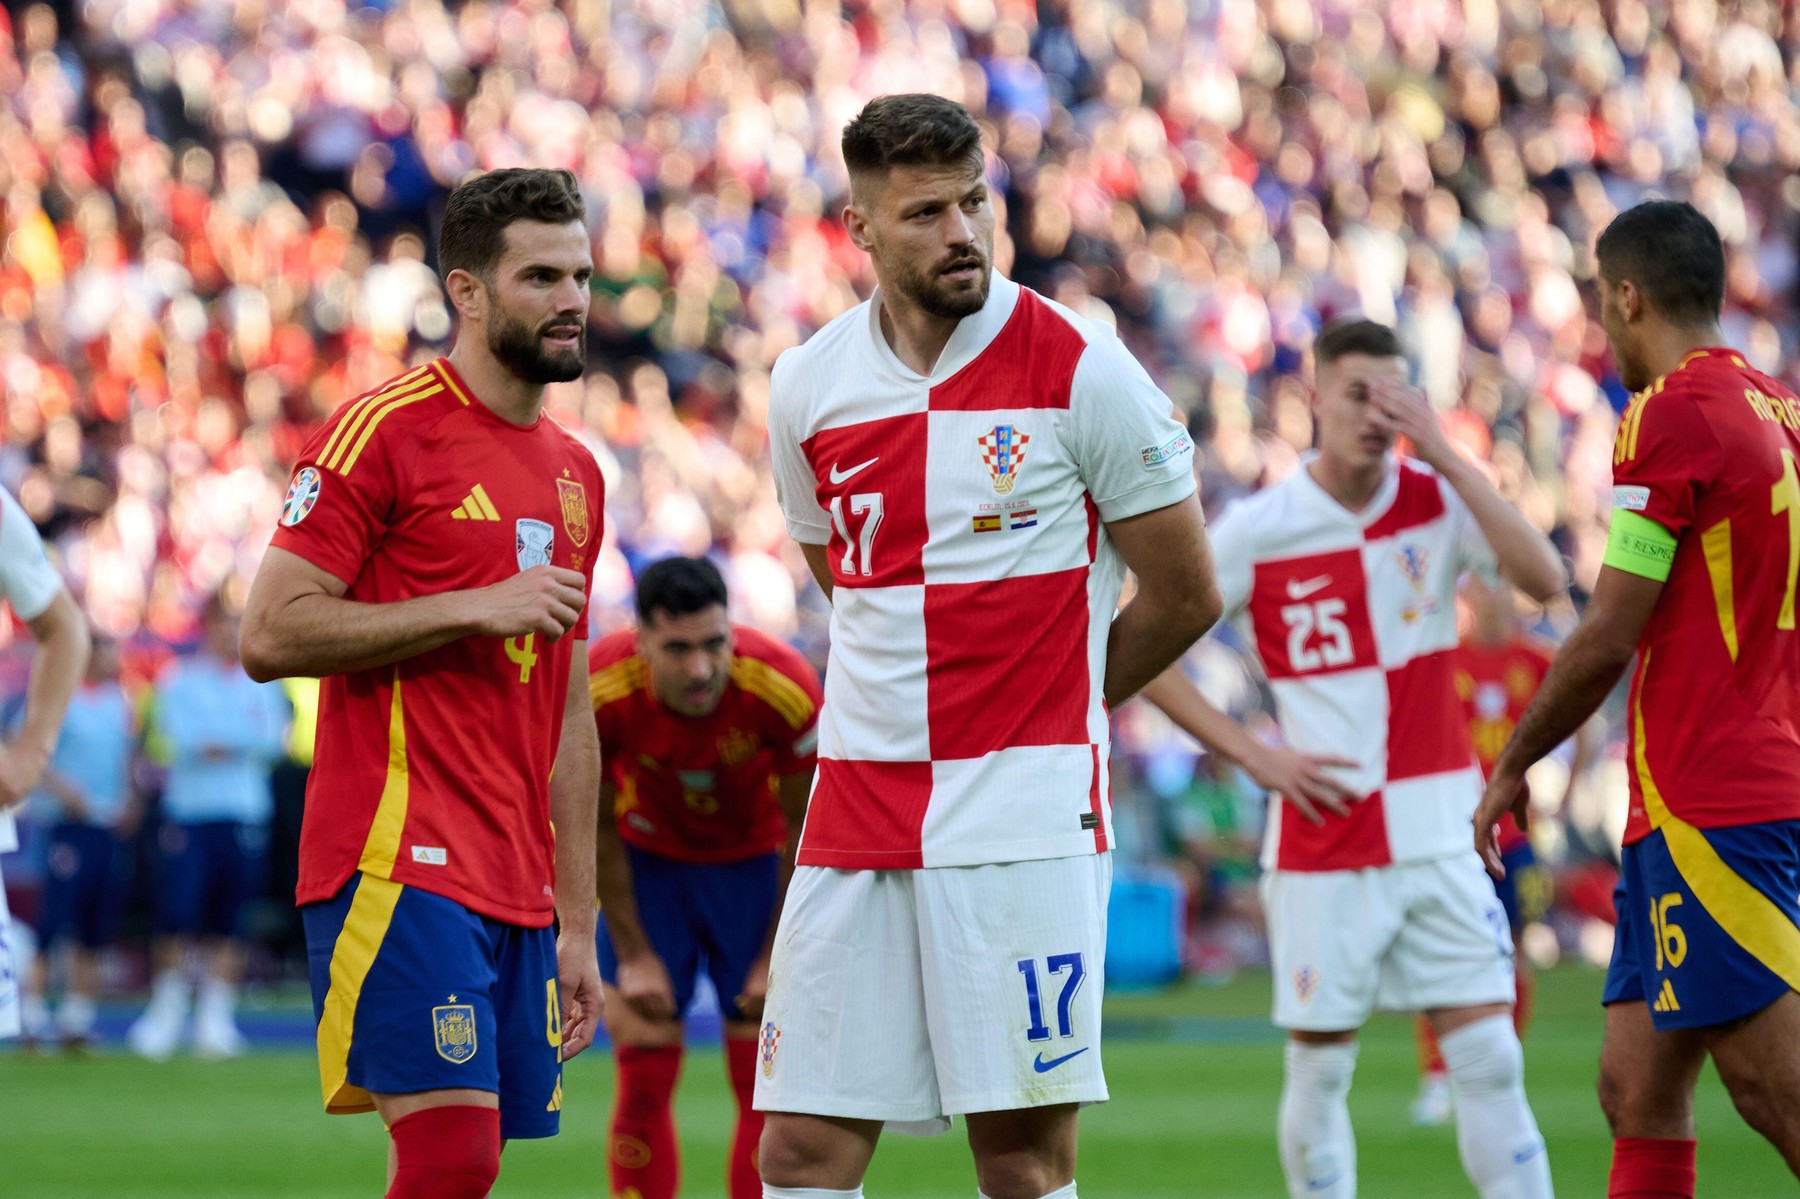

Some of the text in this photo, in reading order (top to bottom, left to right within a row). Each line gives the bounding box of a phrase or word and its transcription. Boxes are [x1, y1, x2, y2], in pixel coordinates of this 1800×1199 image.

[999, 430, 1009, 467] HNS
[1142, 434, 1188, 464] FOUNDATION
[829, 492, 885, 577] 17
[504, 631, 538, 684] 4
[1280, 597, 1356, 673] 25
[1649, 892, 1688, 971] 16
[546, 977, 563, 1064] 4
[1017, 952, 1088, 1043] 17
